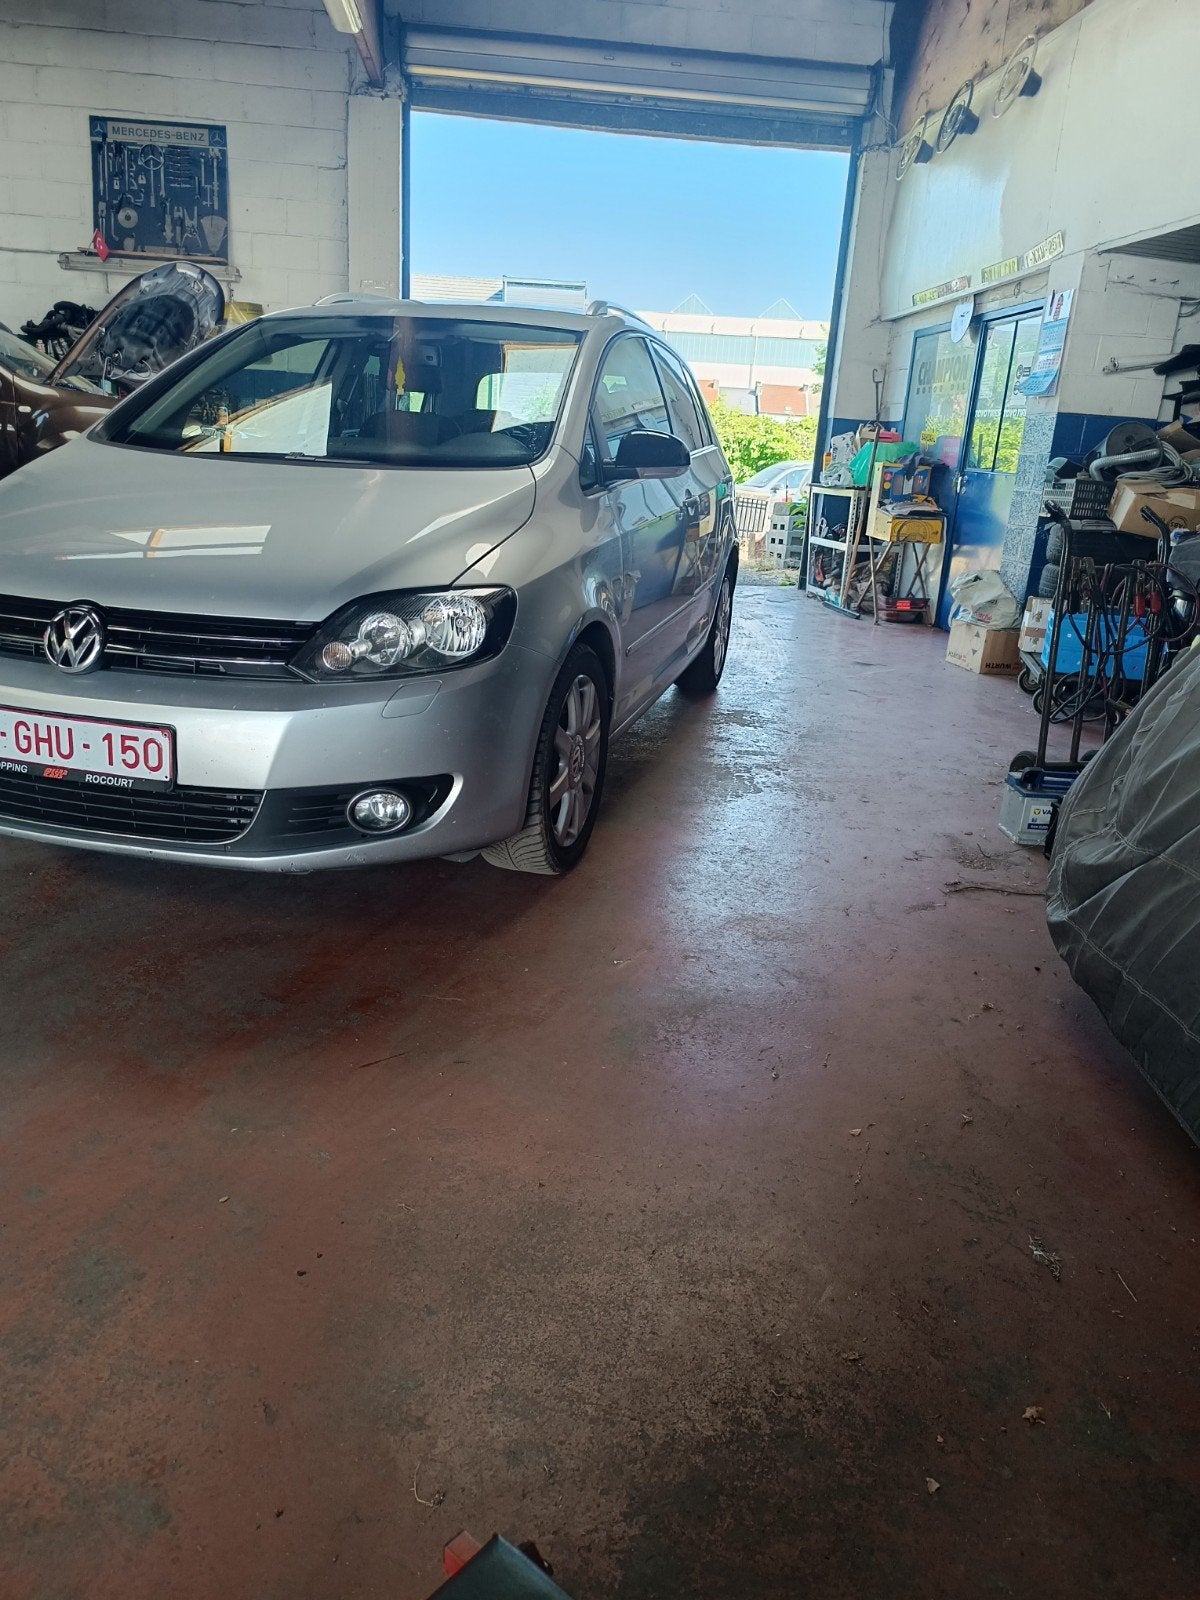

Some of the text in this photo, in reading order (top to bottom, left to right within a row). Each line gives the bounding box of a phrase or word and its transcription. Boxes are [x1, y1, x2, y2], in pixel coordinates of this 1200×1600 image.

[112, 126, 205, 142] MERCEDES-BENZ
[0, 761, 134, 787] PPING ROCOURT
